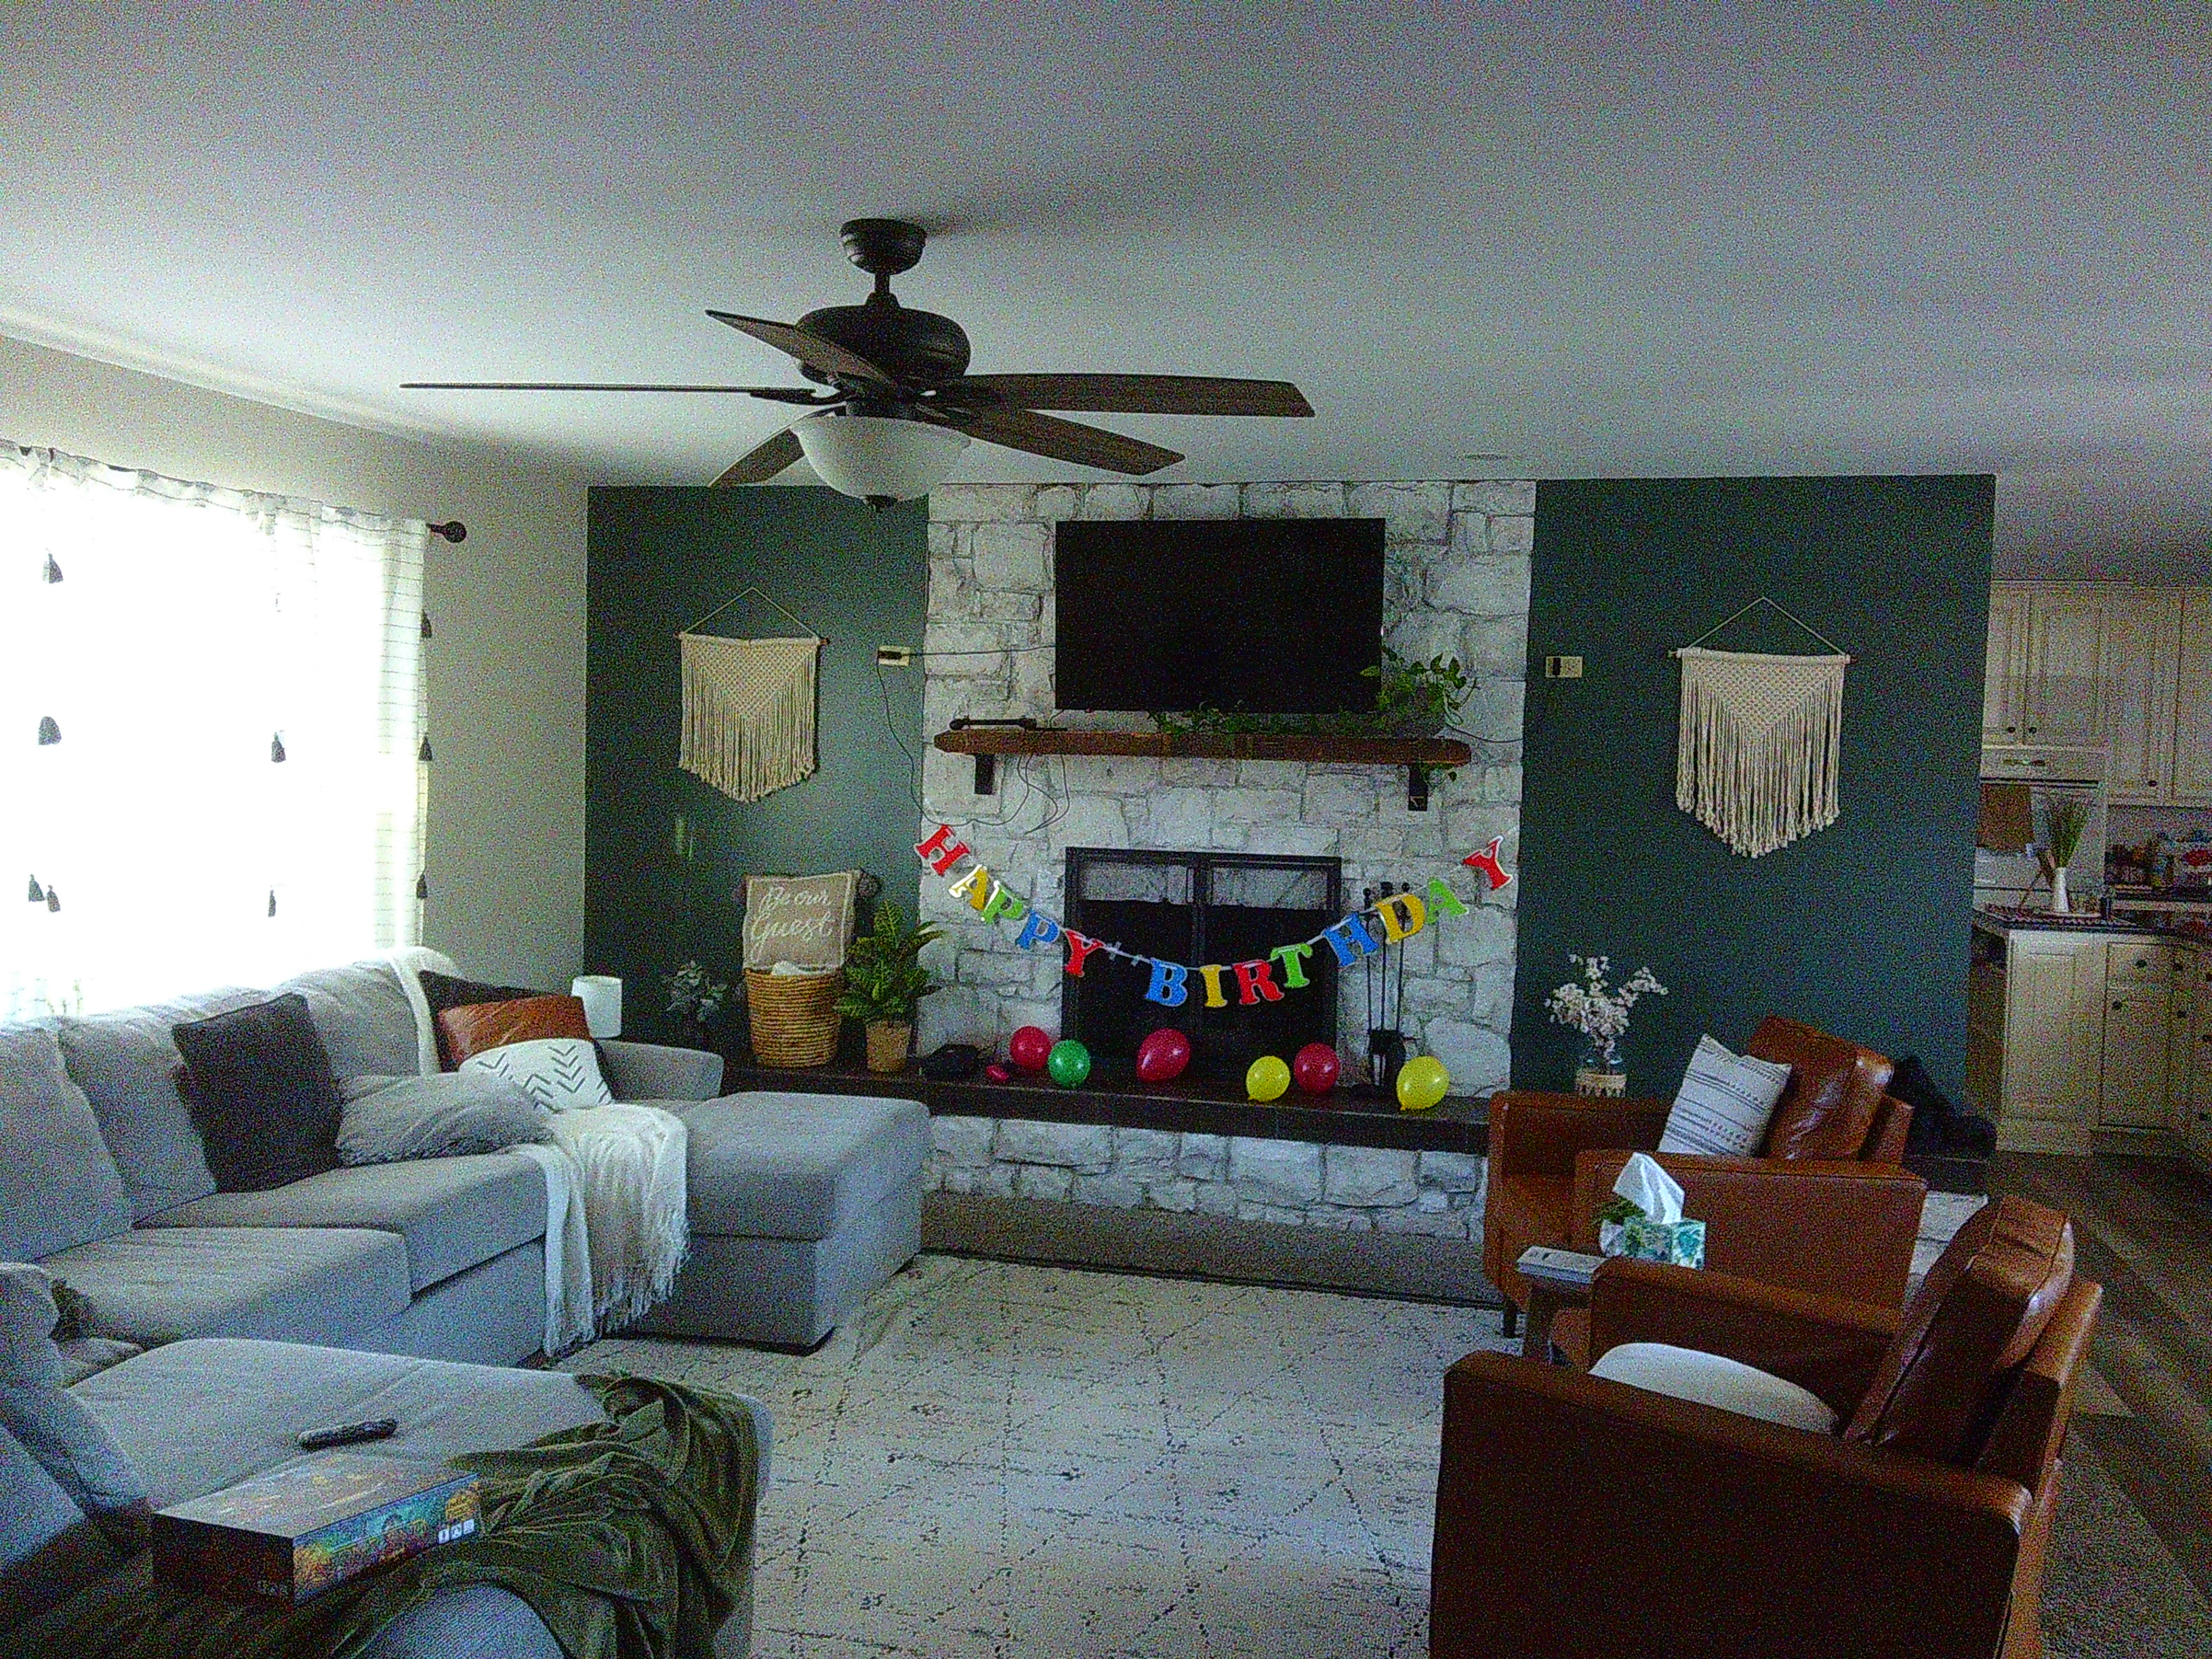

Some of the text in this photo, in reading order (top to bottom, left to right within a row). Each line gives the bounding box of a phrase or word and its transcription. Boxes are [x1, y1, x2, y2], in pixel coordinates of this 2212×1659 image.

[758, 886, 792, 913] Be
[915, 824, 1513, 1008] HAPPY BIRTHDAY
[750, 910, 836, 962] Guest
